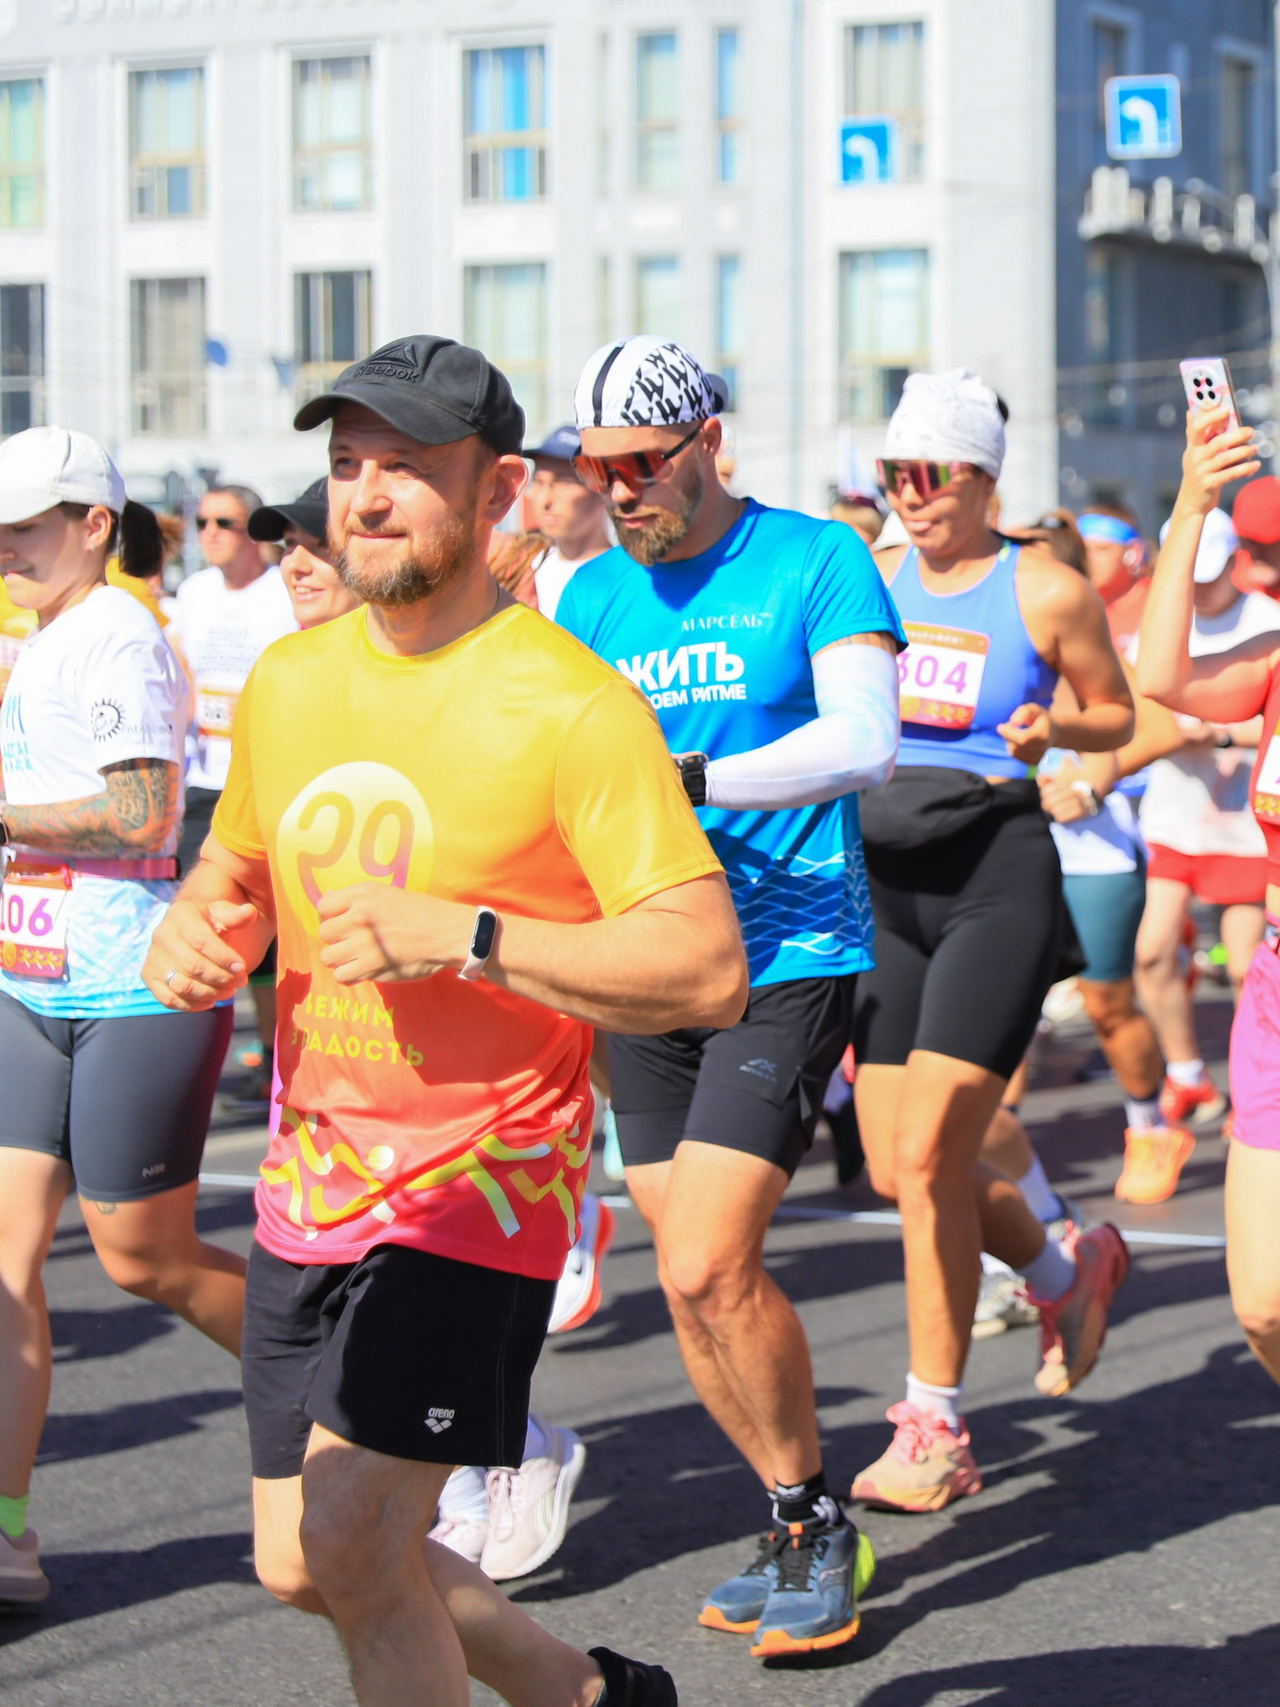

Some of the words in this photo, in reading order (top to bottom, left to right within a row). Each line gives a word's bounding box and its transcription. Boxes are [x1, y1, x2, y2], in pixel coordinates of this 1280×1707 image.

[681, 613, 764, 632] МАРСЕЛЬ
[616, 641, 745, 691] ЖИТЬ
[648, 689, 689, 710] ОЕМ
[691, 683, 747, 703] РИТМЕ
[297, 791, 415, 907] 29
[428, 1407, 455, 1419] arena
